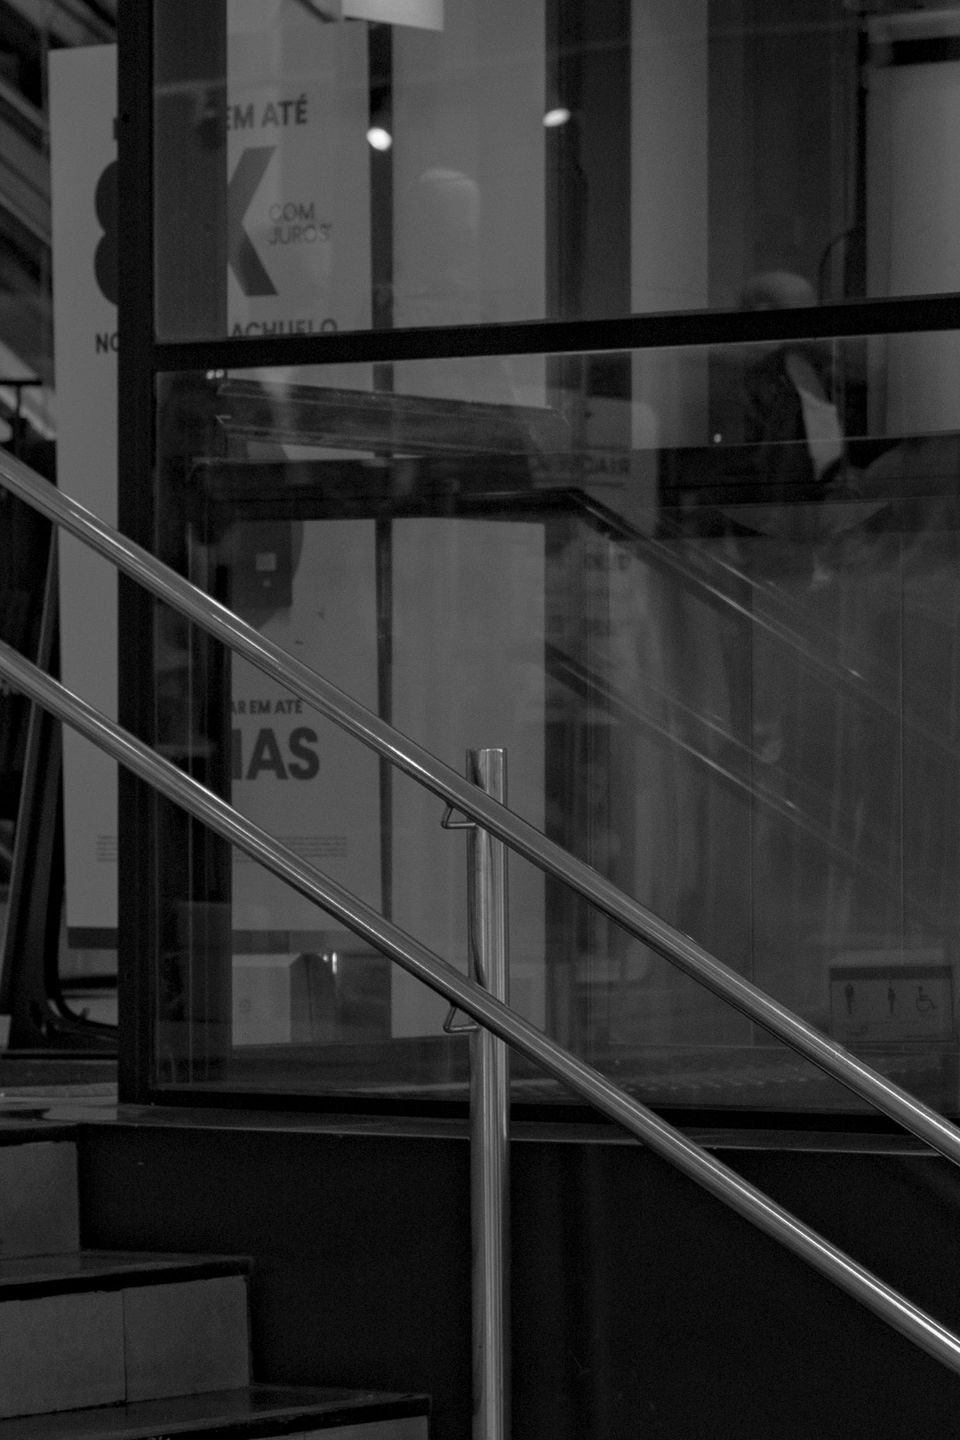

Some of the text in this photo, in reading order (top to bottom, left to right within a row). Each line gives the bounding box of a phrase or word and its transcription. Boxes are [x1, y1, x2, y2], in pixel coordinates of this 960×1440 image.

[261, 92, 309, 129] ATÉ
[231, 317, 339, 338] ACHUELO
[231, 727, 320, 780] IAS
